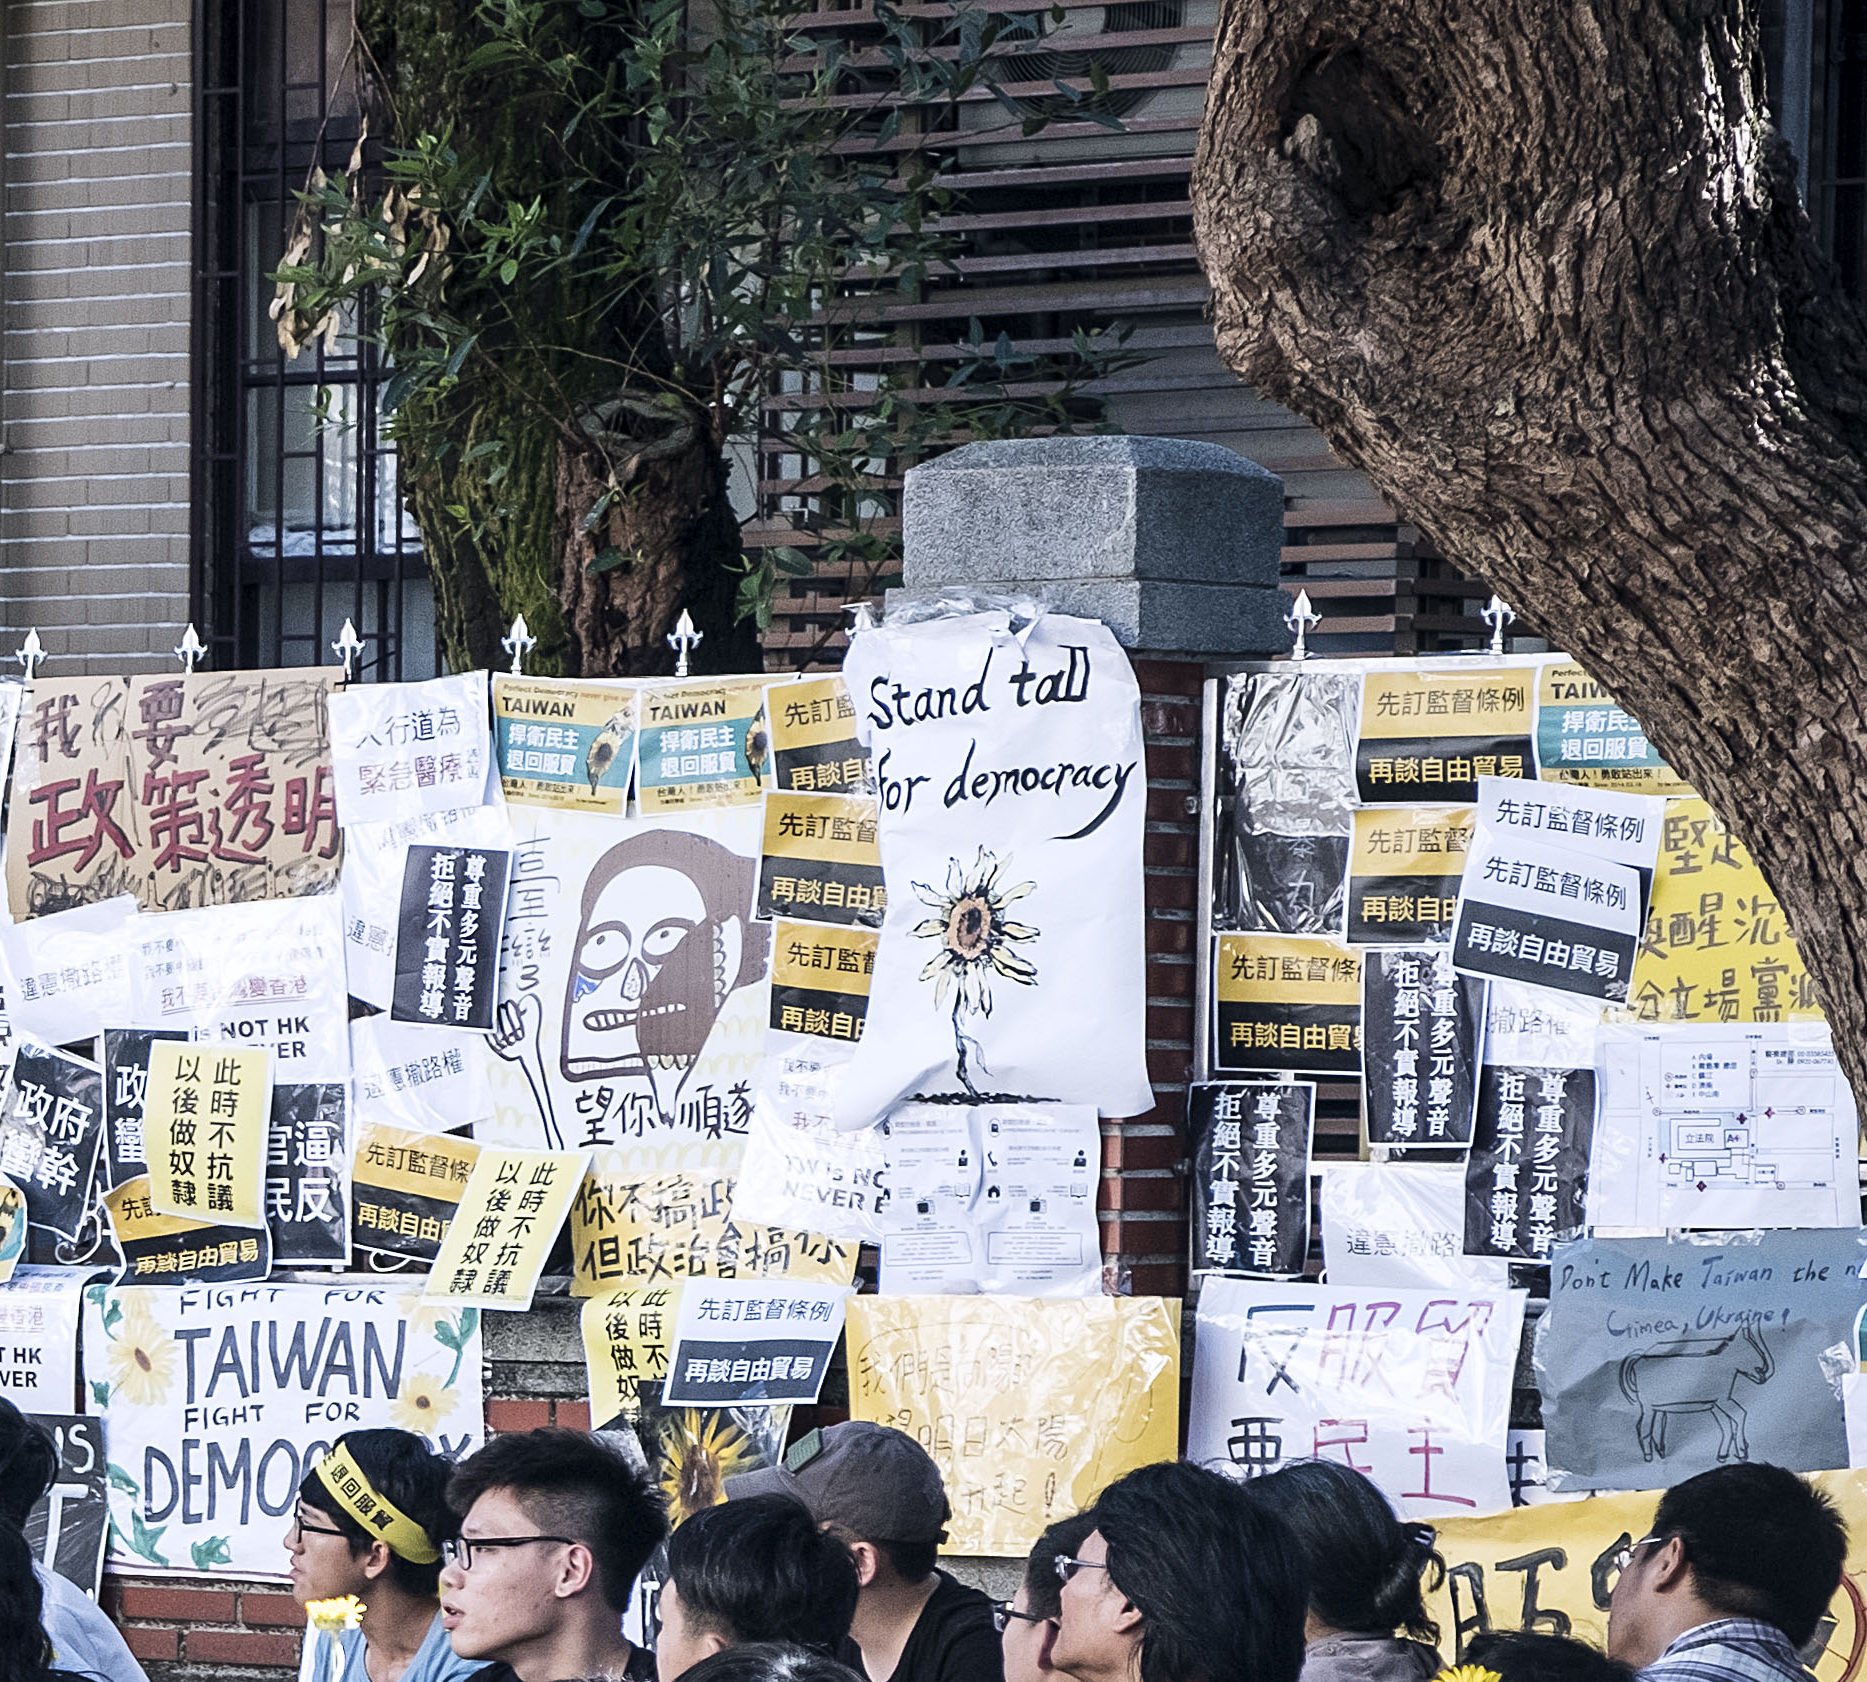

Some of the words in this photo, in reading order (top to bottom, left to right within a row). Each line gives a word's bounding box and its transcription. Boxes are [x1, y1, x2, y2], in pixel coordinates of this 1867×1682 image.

[502, 696, 576, 719] TAIWAN
[650, 699, 727, 722] TAIWAN
[868, 646, 994, 730] Stand
[1009, 645, 1091, 708] tall
[1377, 687, 1526, 717] 先訂監督條例
[506, 749, 577, 777] 退回服貿
[508, 722, 580, 751] 捍衛民主
[658, 725, 736, 753] 捍衛民主
[658, 751, 738, 778] 退回服貿
[1561, 735, 1649, 761] 退回服貿
[877, 748, 931, 815] for
[944, 738, 1139, 840] democracy
[1368, 755, 1525, 784] 再談自由貿易
[27, 753, 338, 871] 政策透明
[1496, 797, 1645, 844] 先訂監督條例
[1484, 855, 1627, 912] 先訂監督條例
[418, 851, 457, 1020] 拒絕不實報導
[453, 855, 488, 1021] 尊重多元聲音
[1467, 920, 1621, 979] 再談自由貿易
[220, 1020, 268, 1040] NOT
[278, 1016, 310, 1035] HK
[1393, 960, 1421, 1138] 拒絕不實報導
[14, 1082, 94, 1147] 政府
[169, 1055, 202, 1207] 以後做奴隸
[205, 1056, 242, 1213] 此時不抗議
[1207, 1093, 1243, 1264] 拒絕不實報導
[1249, 1094, 1282, 1266] 尊重多元聲音
[1489, 1072, 1526, 1252] 拒絕不實報導
[1528, 1073, 1567, 1253] 尊重多元聲音
[448, 1159, 523, 1294] 以後做奴隸
[483, 1161, 559, 1296] 此時不抗議
[133, 1243, 260, 1277] 再談自由貿易
[1560, 1258, 1611, 1292] Don't
[1624, 1259, 1684, 1291] Make
[1690, 1255, 1773, 1288] Taiwan
[1793, 1258, 1830, 1283] the
[180, 1288, 285, 1315] FIGHT
[325, 1287, 387, 1306] FOR
[697, 1297, 834, 1325] 先訂監督條例
[13, 1345, 44, 1365] HK
[174, 1316, 407, 1406] TAIWAN
[684, 1357, 813, 1385] 再談自由貿易
[1238, 1299, 1495, 1402] 反服貿
[184, 1403, 265, 1431] FIGHT
[305, 1402, 361, 1425] FOR
